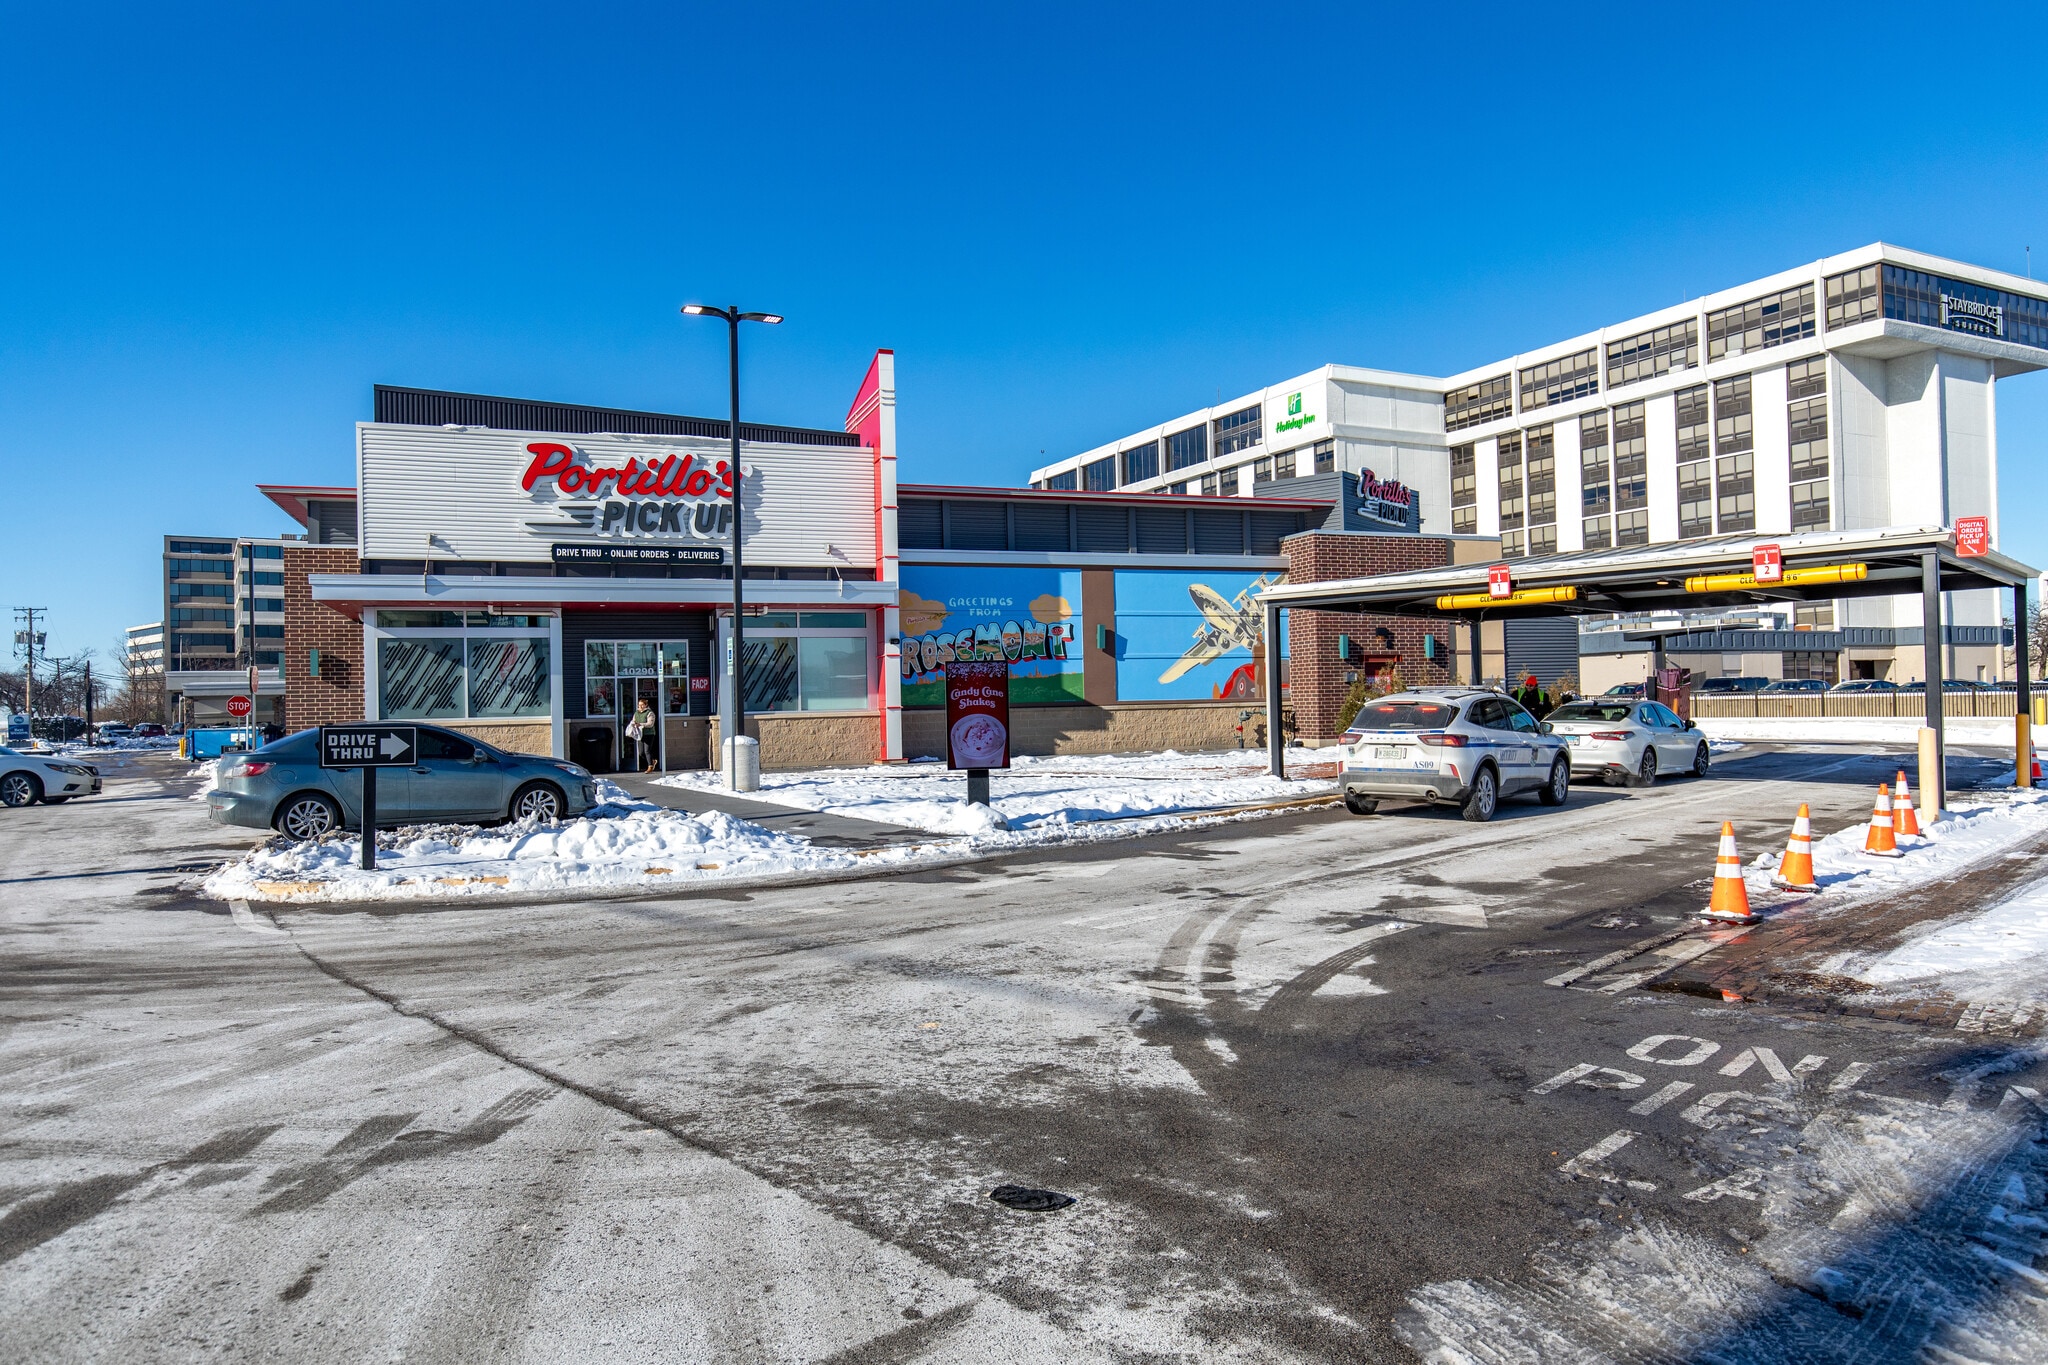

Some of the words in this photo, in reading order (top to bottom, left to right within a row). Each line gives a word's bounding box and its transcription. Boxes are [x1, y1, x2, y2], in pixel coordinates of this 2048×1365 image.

[1948, 296, 1997, 319] STAYBRIDGE
[1955, 320, 1990, 333] SUITES
[1276, 417, 1303, 434] Holiday
[1304, 413, 1316, 425] Inn
[521, 442, 743, 497] Portillo's
[1363, 469, 1411, 506] Portillo's
[601, 501, 685, 533] PICK
[1381, 503, 1399, 521] PICK
[556, 548, 580, 557] DRIVE
[581, 549, 602, 557] THRU
[610, 549, 638, 558] ONLINE
[640, 550, 670, 559] ORDERS
[678, 551, 720, 560] DELIVERIES
[1764, 565, 1770, 575] 2
[1497, 583, 1501, 592] 1
[949, 597, 1014, 607] GREETINGS
[969, 608, 1001, 616] FROM
[901, 620, 1074, 679] ROSEMONT
[623, 667, 655, 675] 10290
[691, 679, 708, 689] FACP
[950, 686, 980, 700] Candy
[981, 686, 1004, 698] Cane
[228, 702, 250, 710] STOP
[958, 698, 996, 709] Shakes
[328, 734, 376, 746] DRIVE
[331, 747, 374, 759] THRU
[1413, 761, 1434, 769] AS09
